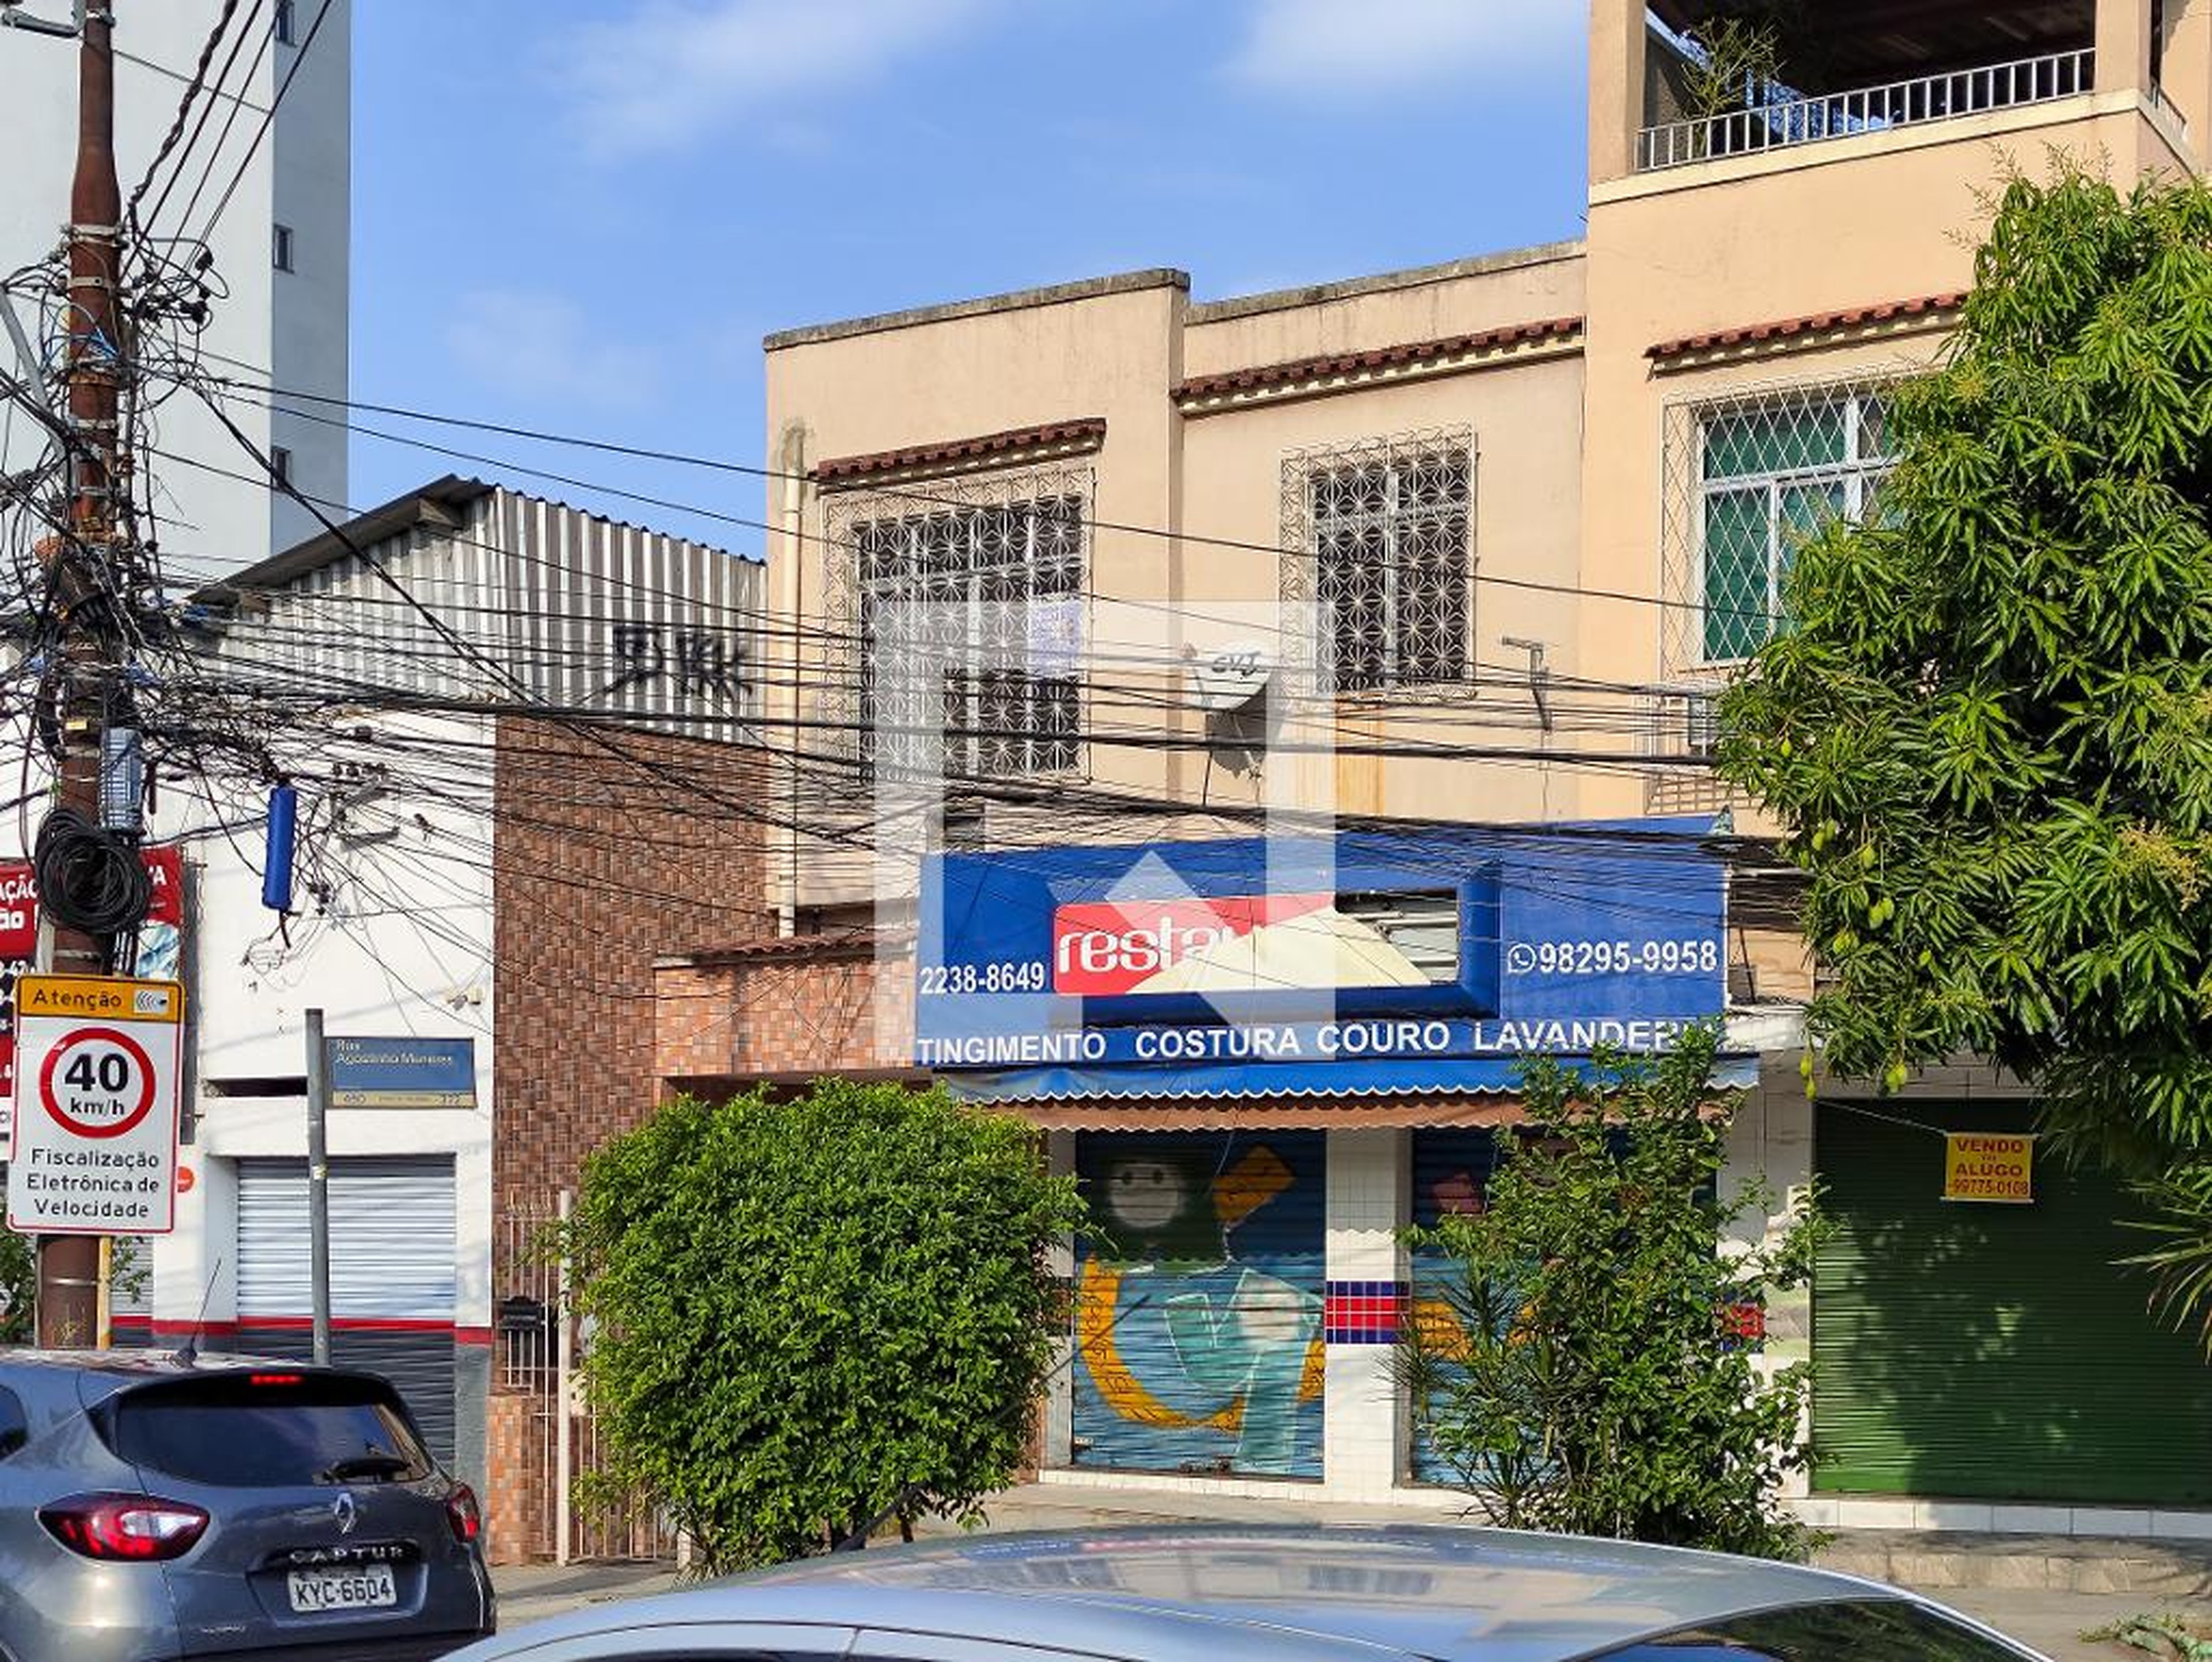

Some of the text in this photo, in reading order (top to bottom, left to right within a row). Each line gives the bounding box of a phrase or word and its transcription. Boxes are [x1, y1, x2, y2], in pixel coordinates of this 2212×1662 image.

[1539, 940, 1718, 974] 98295-9958
[921, 961, 1044, 993] 2238-8649
[32, 988, 122, 1011] Atenção
[917, 1033, 1106, 1064] TINGIMENTO
[1135, 1027, 1300, 1058] COSTURA
[1316, 1021, 1450, 1053] COURO
[64, 1052, 129, 1093] 40
[70, 1097, 125, 1116] km/h
[1956, 1139, 2024, 1153] VENDO
[31, 1148, 160, 1171] Fiscalização
[1956, 1163, 2023, 1177] ALUGO
[26, 1172, 160, 1193] Eletrônica de
[34, 1198, 150, 1217] Velocidade
[289, 1546, 404, 1563] CAPTUR
[295, 1577, 391, 1606] KYC-6604
